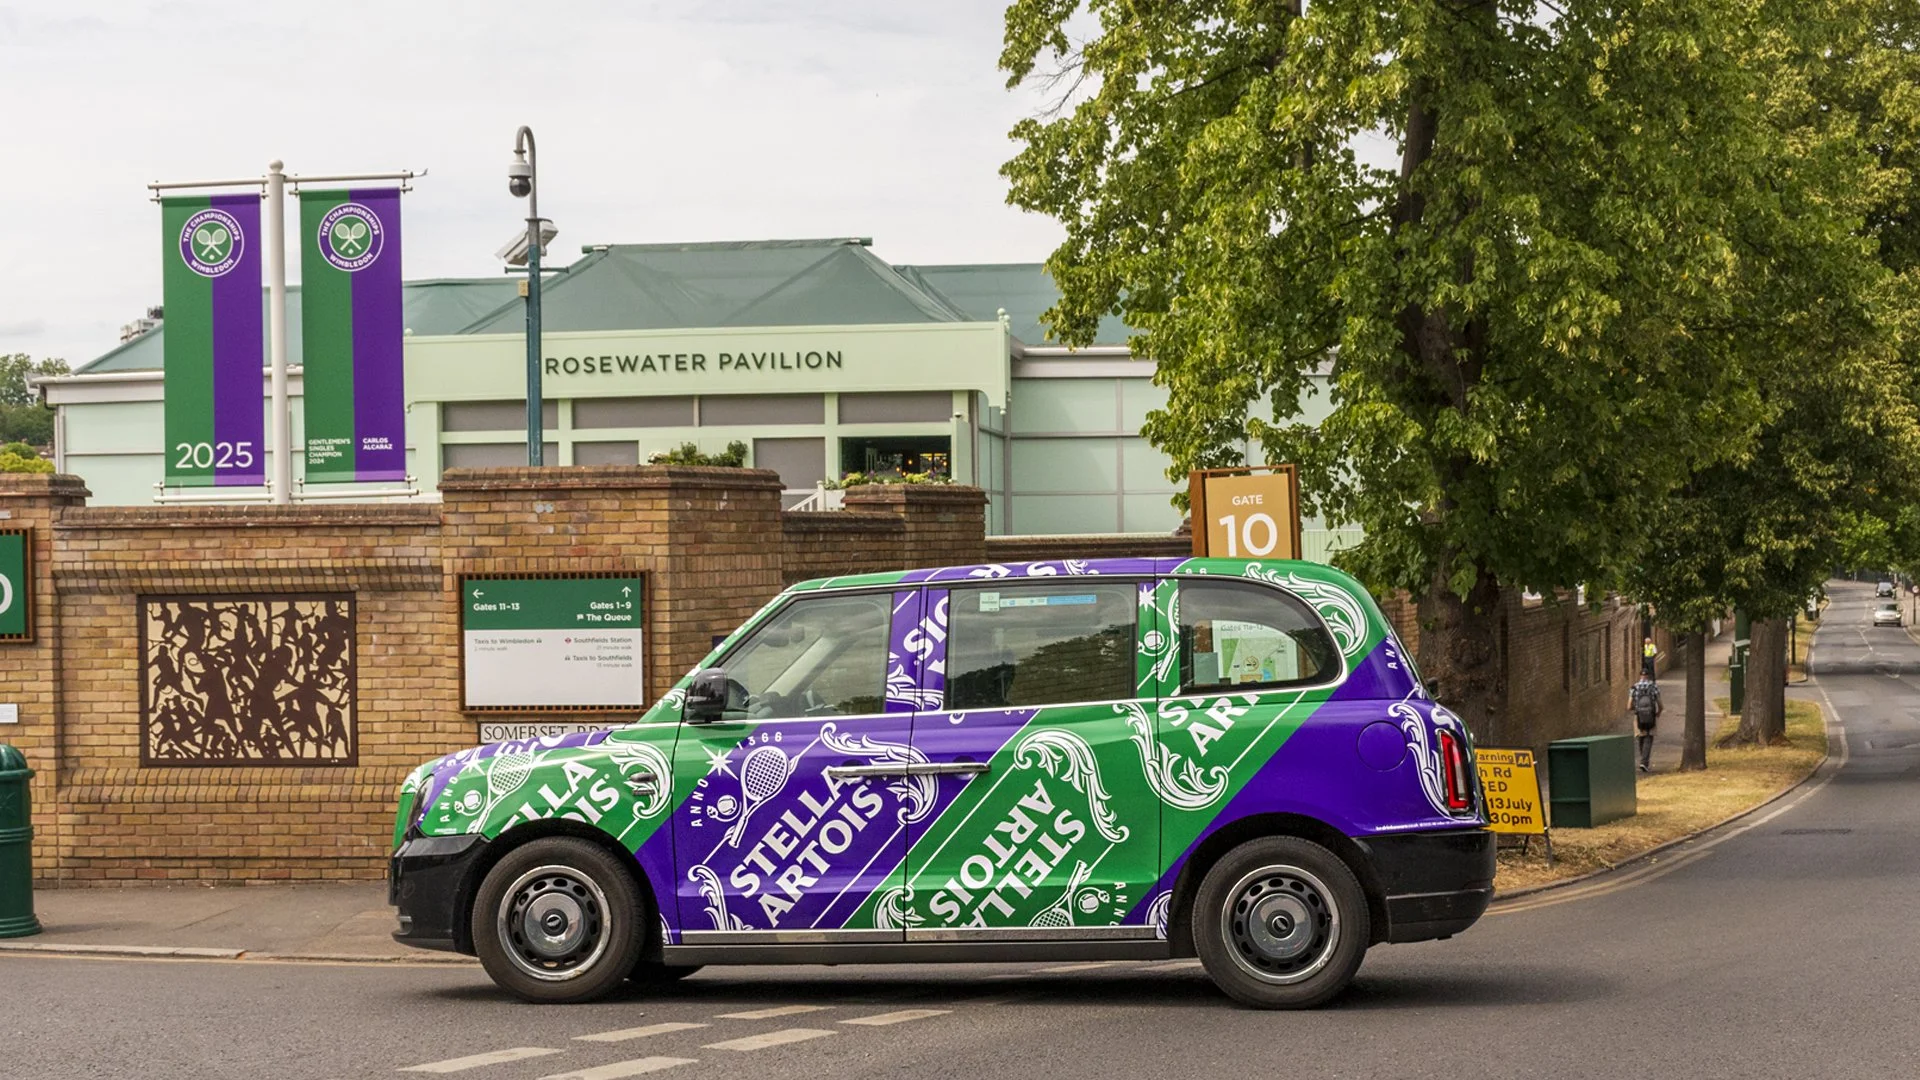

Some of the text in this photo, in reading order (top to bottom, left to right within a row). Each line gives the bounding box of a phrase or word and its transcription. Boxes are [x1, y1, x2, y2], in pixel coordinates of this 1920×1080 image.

[183, 212, 240, 243] THE CHAMPIONSHIPS
[321, 207, 380, 237] THE CHAMPIONSHIPS
[191, 258, 234, 274] WIMBLEDON
[329, 252, 374, 268] WIMBLEDON
[545, 350, 843, 375] ROSEWATER PAVILION
[175, 441, 254, 468] 2025
[1231, 494, 1264, 506] GATE
[1218, 512, 1278, 558] 10
[473, 603, 497, 611] Gates
[586, 613, 632, 621] The Queue
[590, 602, 614, 610] Gates
[484, 725, 568, 741] SOMERSET
[737, 732, 782, 751] 1366
[1476, 752, 1514, 764] arning
[1493, 767, 1512, 778] Rd
[440, 776, 459, 823] ANNO
[691, 778, 709, 828] ANNO
[730, 766, 855, 899] STELLA
[758, 784, 883, 928] ARTOIS
[929, 778, 1056, 924] ARTOIS
